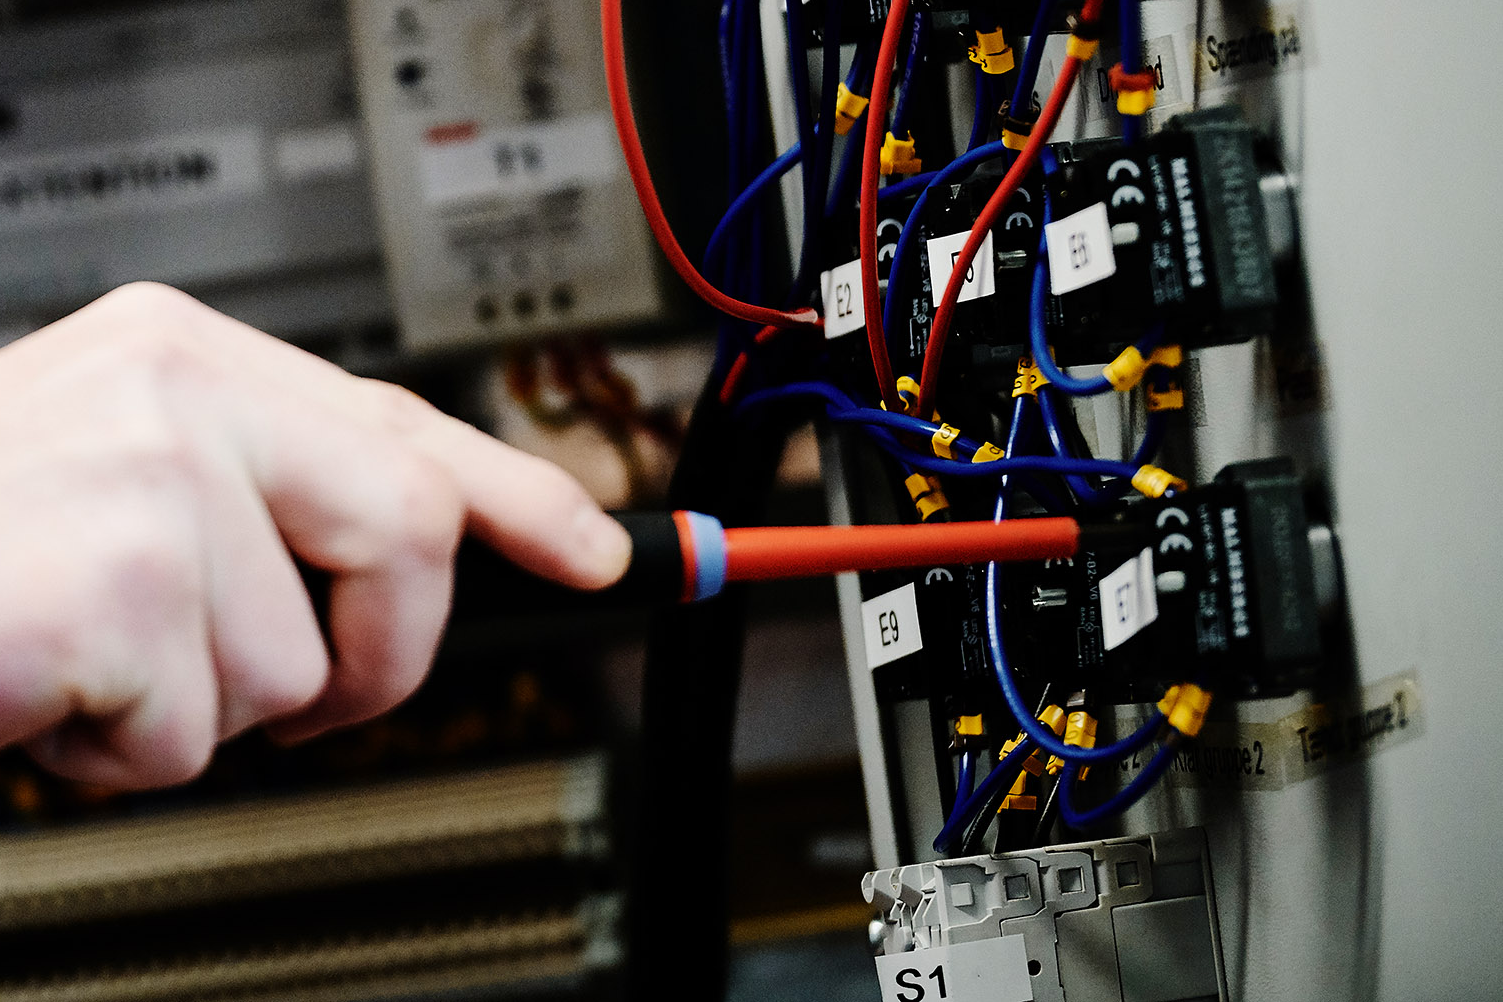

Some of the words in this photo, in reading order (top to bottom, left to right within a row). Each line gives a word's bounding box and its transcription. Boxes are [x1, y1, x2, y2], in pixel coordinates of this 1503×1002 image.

[835, 283, 853, 318] E2
[878, 610, 899, 647] E9
[896, 964, 947, 1002] S1
